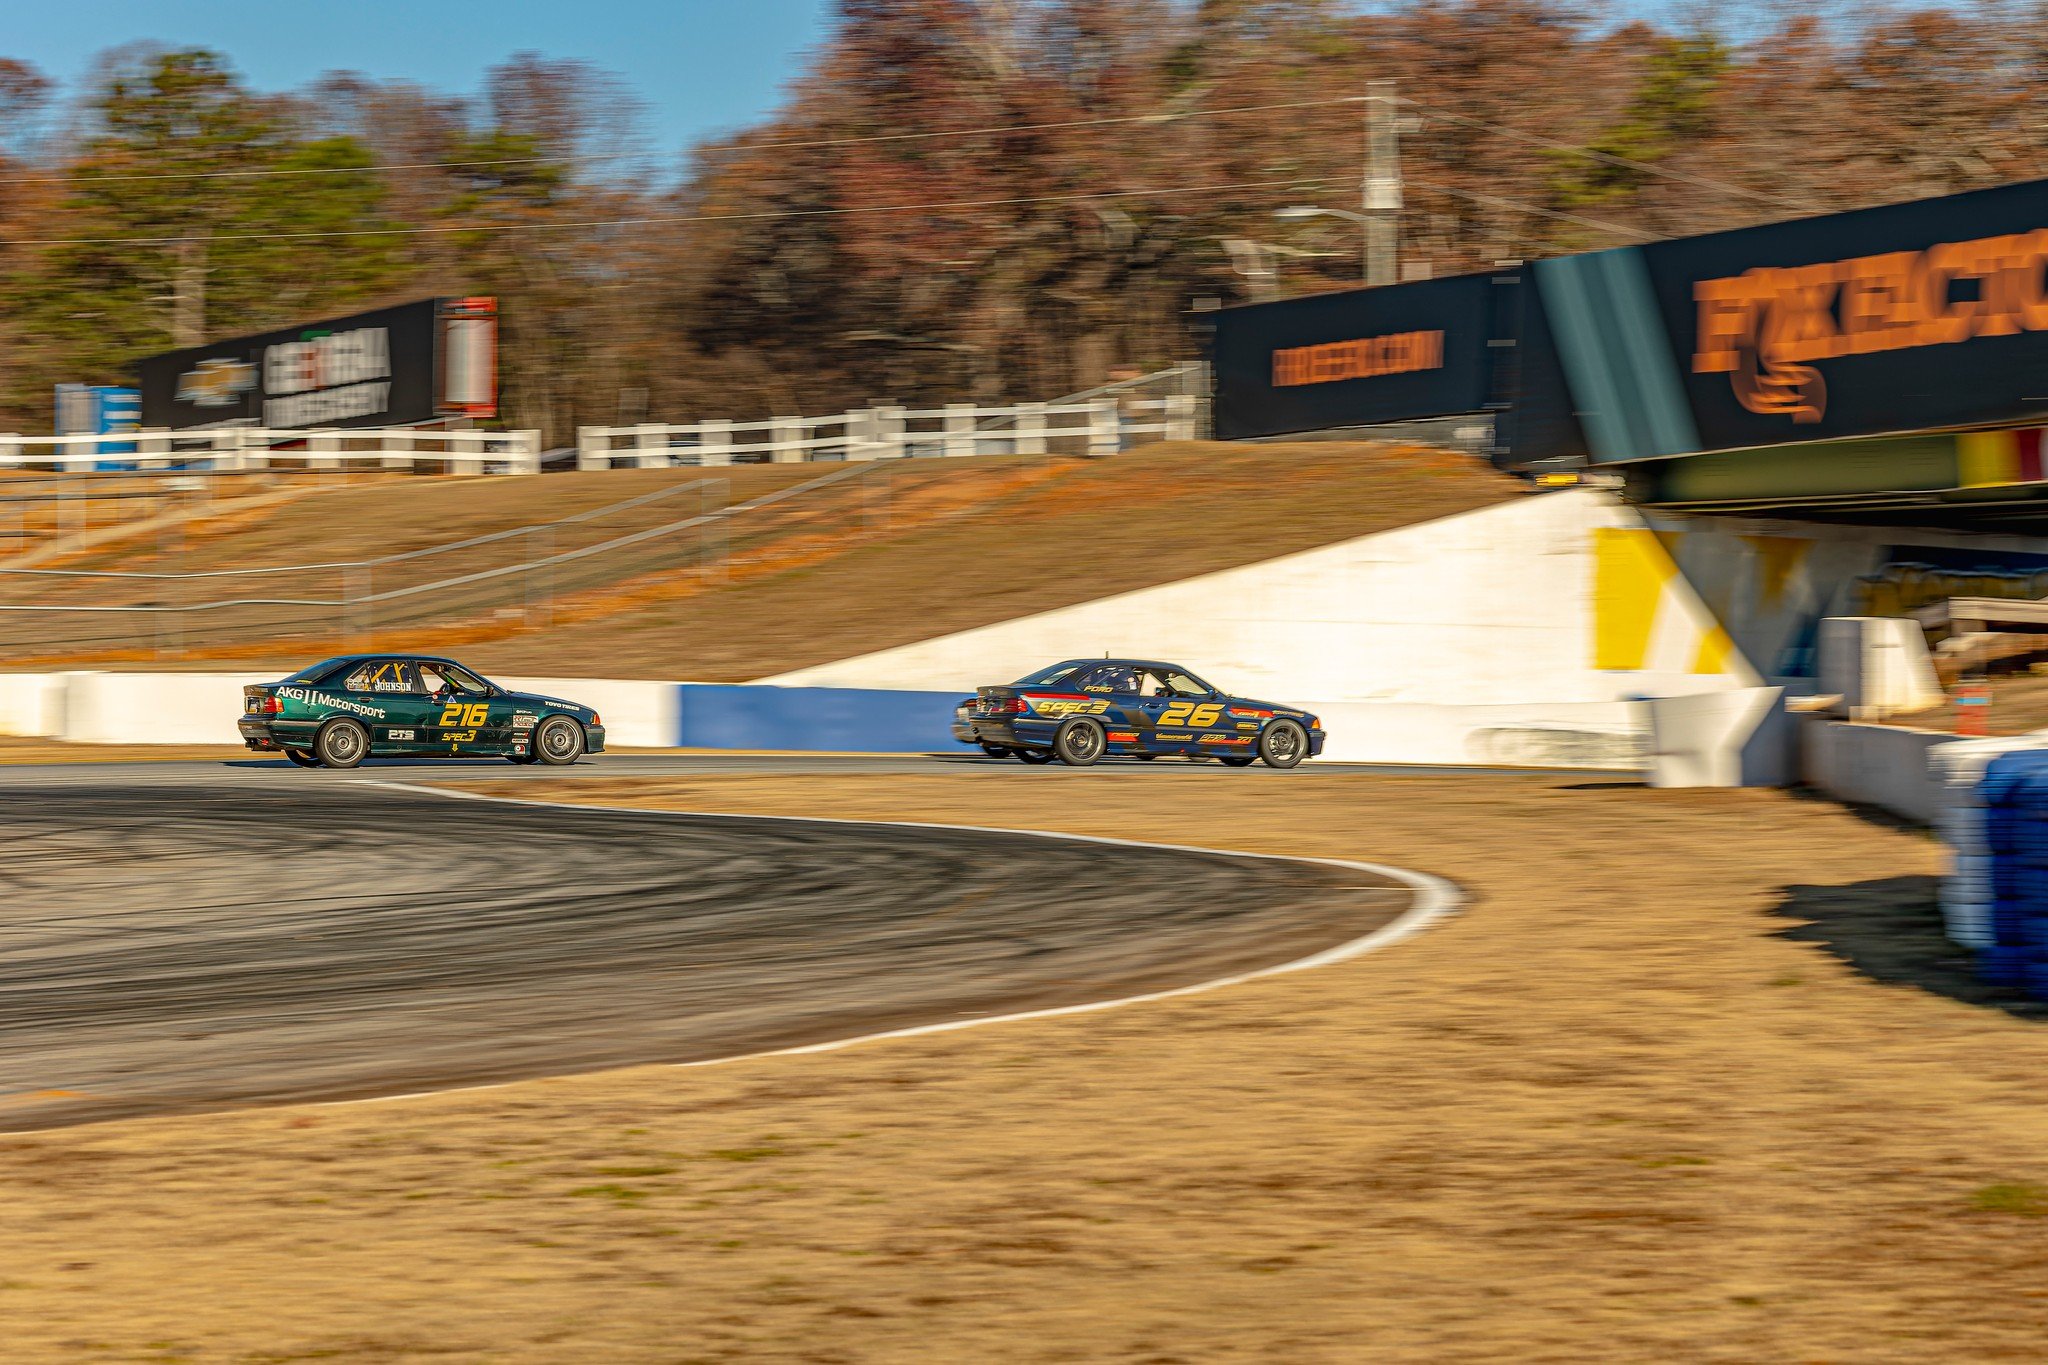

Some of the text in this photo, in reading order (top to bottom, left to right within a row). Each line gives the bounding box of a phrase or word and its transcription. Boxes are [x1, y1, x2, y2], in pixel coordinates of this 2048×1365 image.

[375, 682, 412, 692] JOHNSON
[1083, 685, 1114, 693] FORD
[276, 686, 386, 719] AKG Motorsport
[1036, 699, 1112, 715] SPEC3
[438, 703, 490, 727] 216
[1155, 701, 1227, 727] 26
[441, 729, 477, 742] SPEC3
